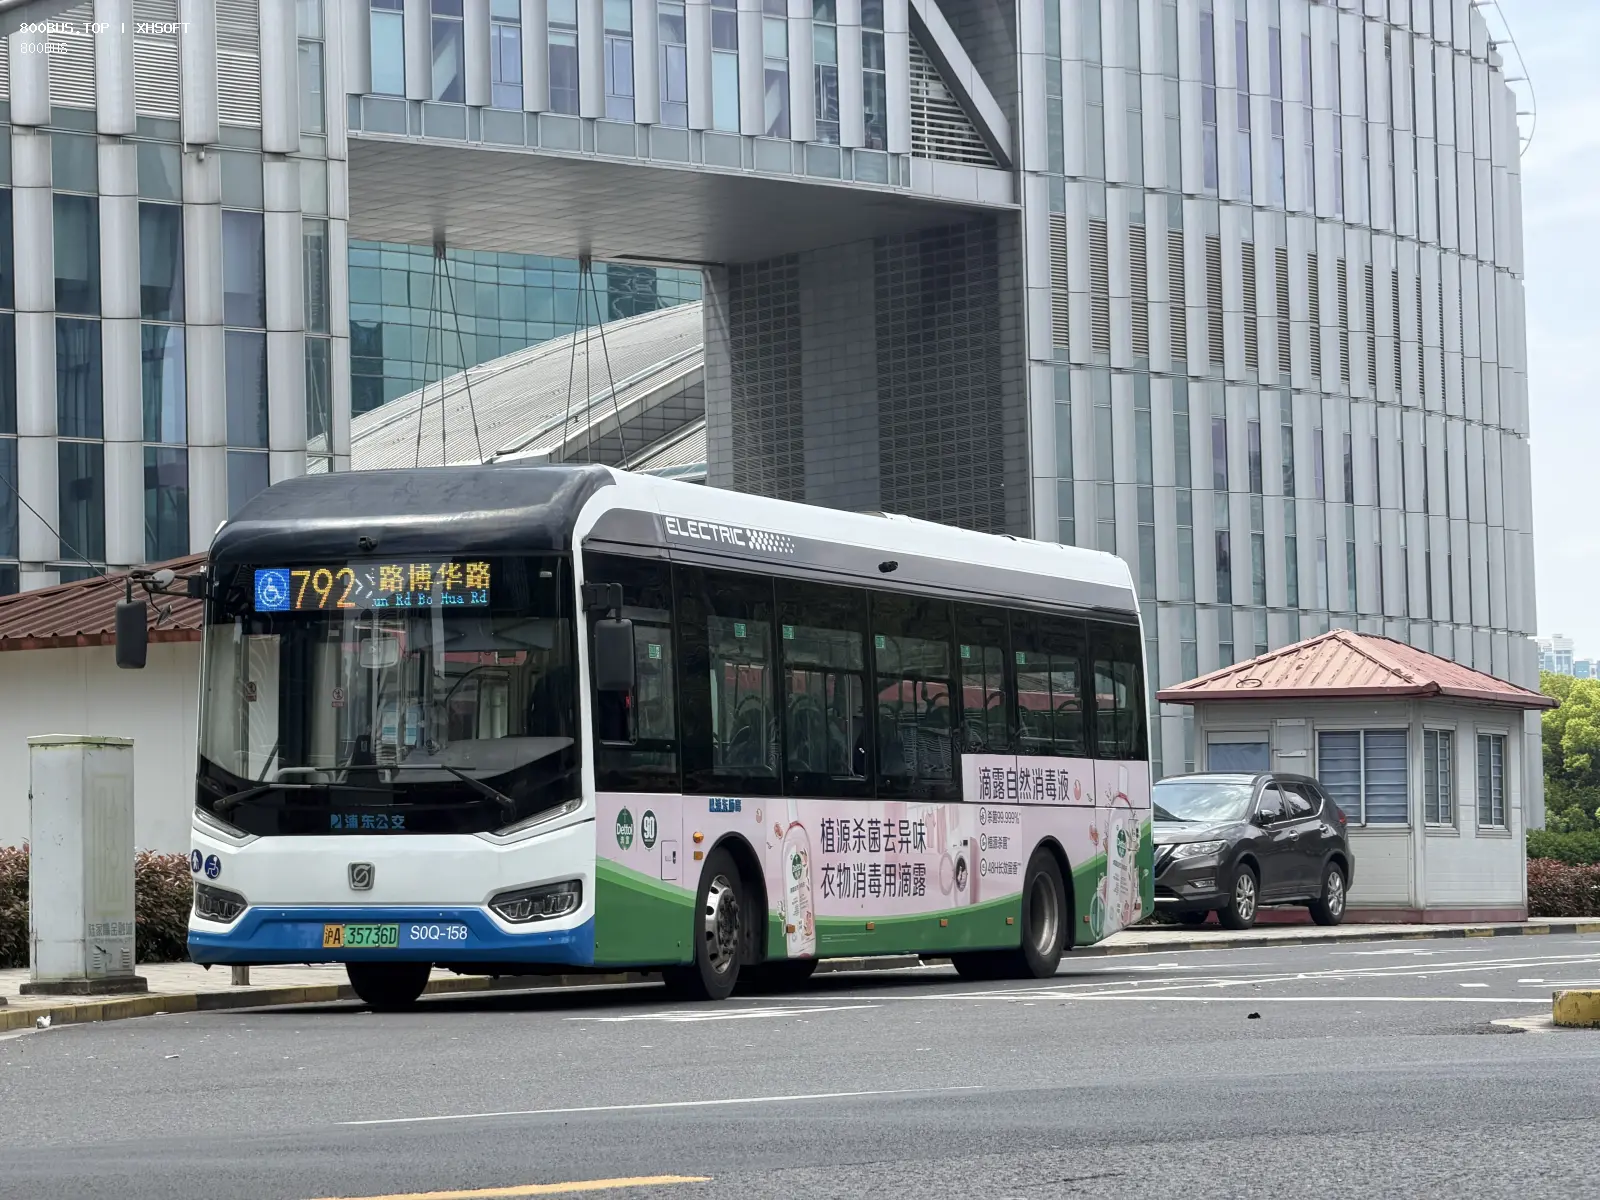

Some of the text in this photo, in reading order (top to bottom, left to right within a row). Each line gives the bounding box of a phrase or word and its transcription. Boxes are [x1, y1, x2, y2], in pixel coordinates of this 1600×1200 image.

[665, 516, 746, 546] ELECTRIC
[290, 567, 356, 609] 792
[379, 561, 491, 592] 路博华路
[396, 591, 412, 606] Rd
[418, 592, 433, 605] Bo
[441, 592, 464, 605] Hua
[471, 589, 487, 604] Rd
[978, 766, 1070, 801] 滴露自然消毒液
[344, 813, 405, 830] 浦东公交
[616, 823, 633, 836] Dettol
[643, 816, 655, 839] 90
[819, 816, 927, 855] 植源杀菌去异味
[820, 861, 927, 900] 衣物消毒用滴露
[347, 927, 398, 945] 35736D
